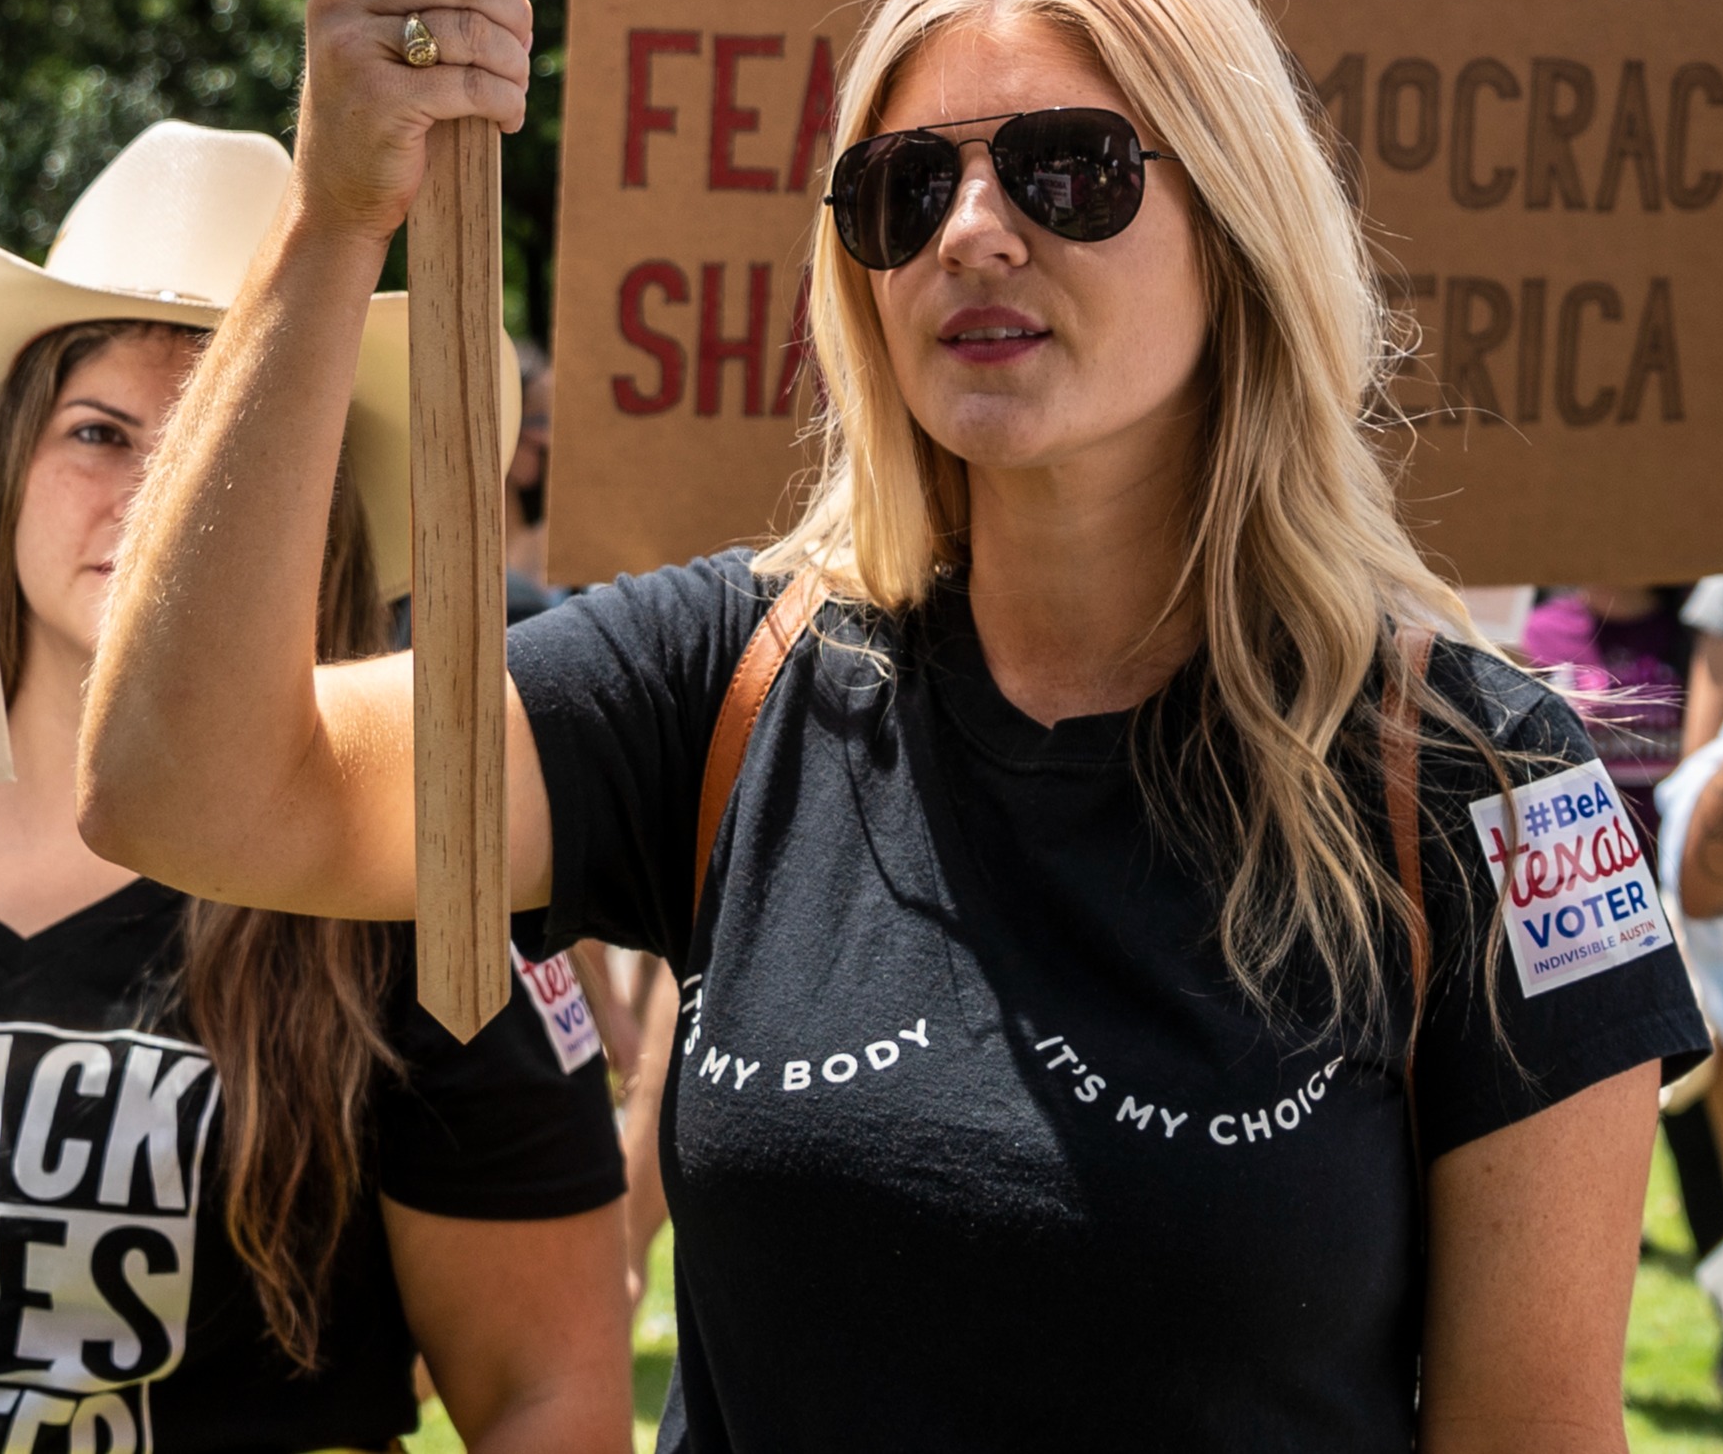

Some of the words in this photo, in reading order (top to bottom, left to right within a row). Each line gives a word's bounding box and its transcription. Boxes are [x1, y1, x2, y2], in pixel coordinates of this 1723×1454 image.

[620, 27, 838, 193] FEA
[1362, 275, 1686, 431] ERICA
[1524, 781, 1614, 837] #BeA
[1489, 815, 1642, 908] texas
[1522, 880, 1649, 949] VOTER
[1534, 935, 1617, 975] INDIVISIBLE
[1619, 919, 1657, 945] AUSTIN
[698, 1045, 760, 1091] MY
[783, 1018, 931, 1092] BODY
[1116, 1095, 1188, 1138] MY
